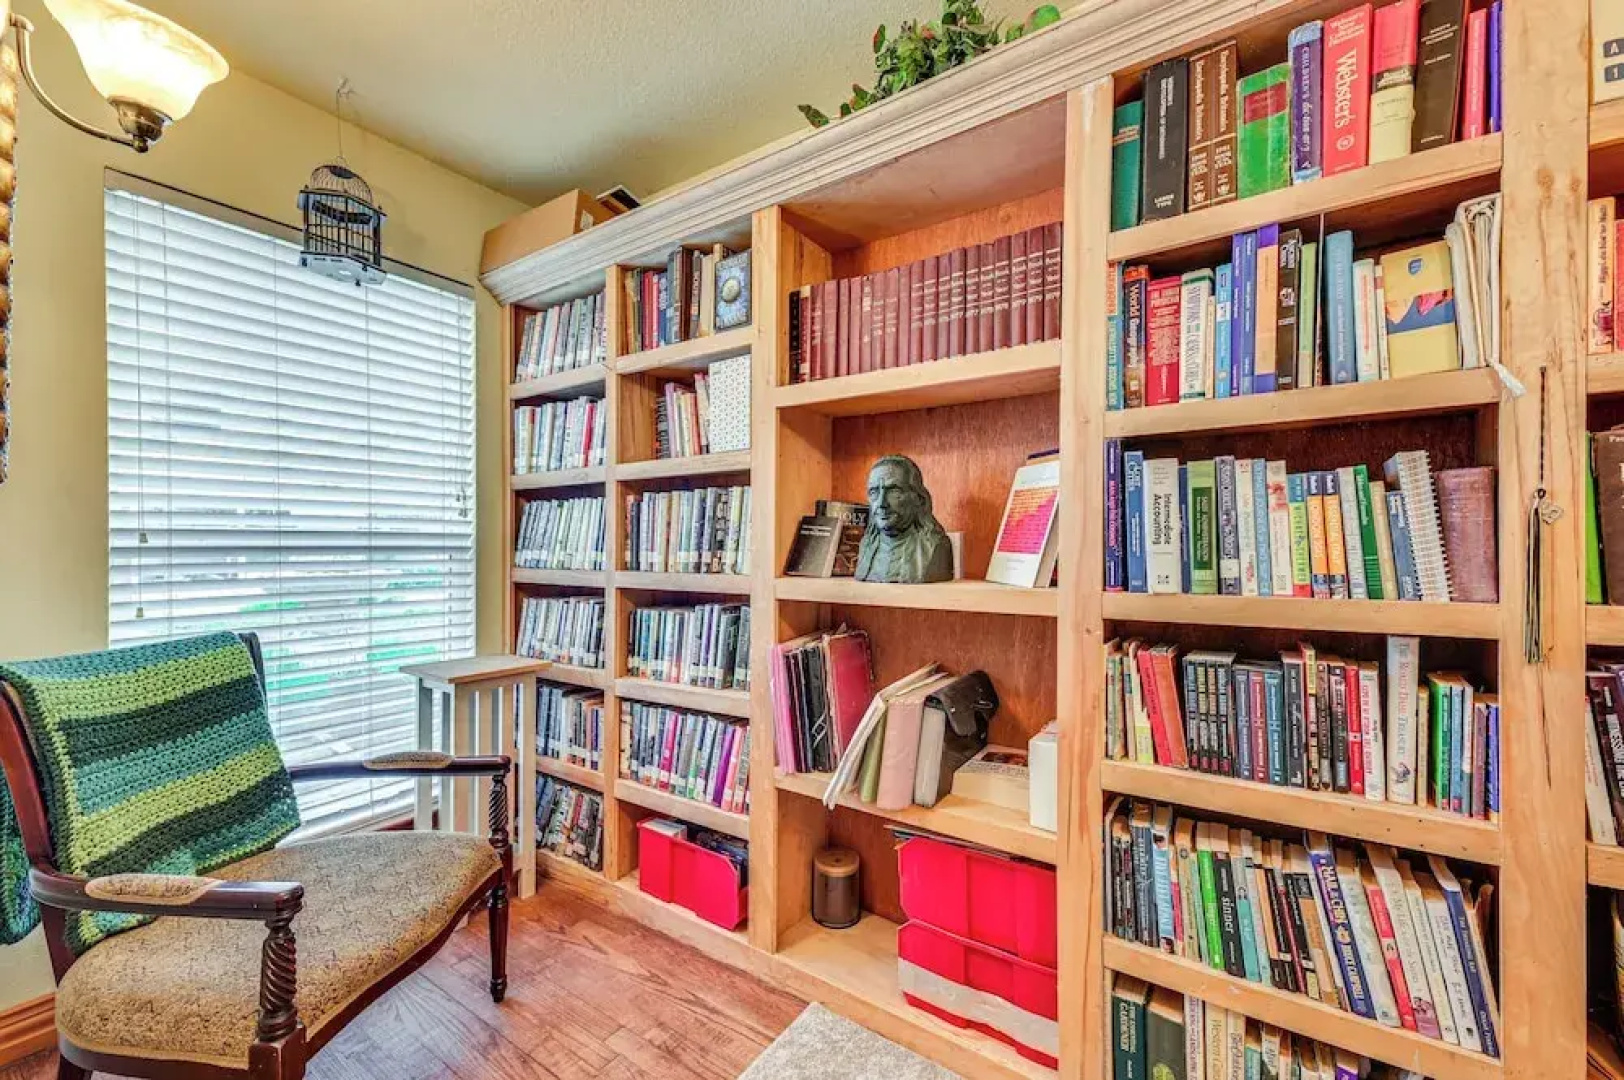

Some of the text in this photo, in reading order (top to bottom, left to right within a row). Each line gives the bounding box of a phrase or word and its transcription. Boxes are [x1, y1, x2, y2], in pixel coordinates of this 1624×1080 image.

[1610, 42, 1620, 54] A
[1334, 47, 1358, 129] Webster's
[1127, 284, 1140, 368] World Geography
[1152, 494, 1163, 545] Accounting
[1163, 493, 1174, 545] Intermediate
[1221, 896, 1234, 934] sinner
